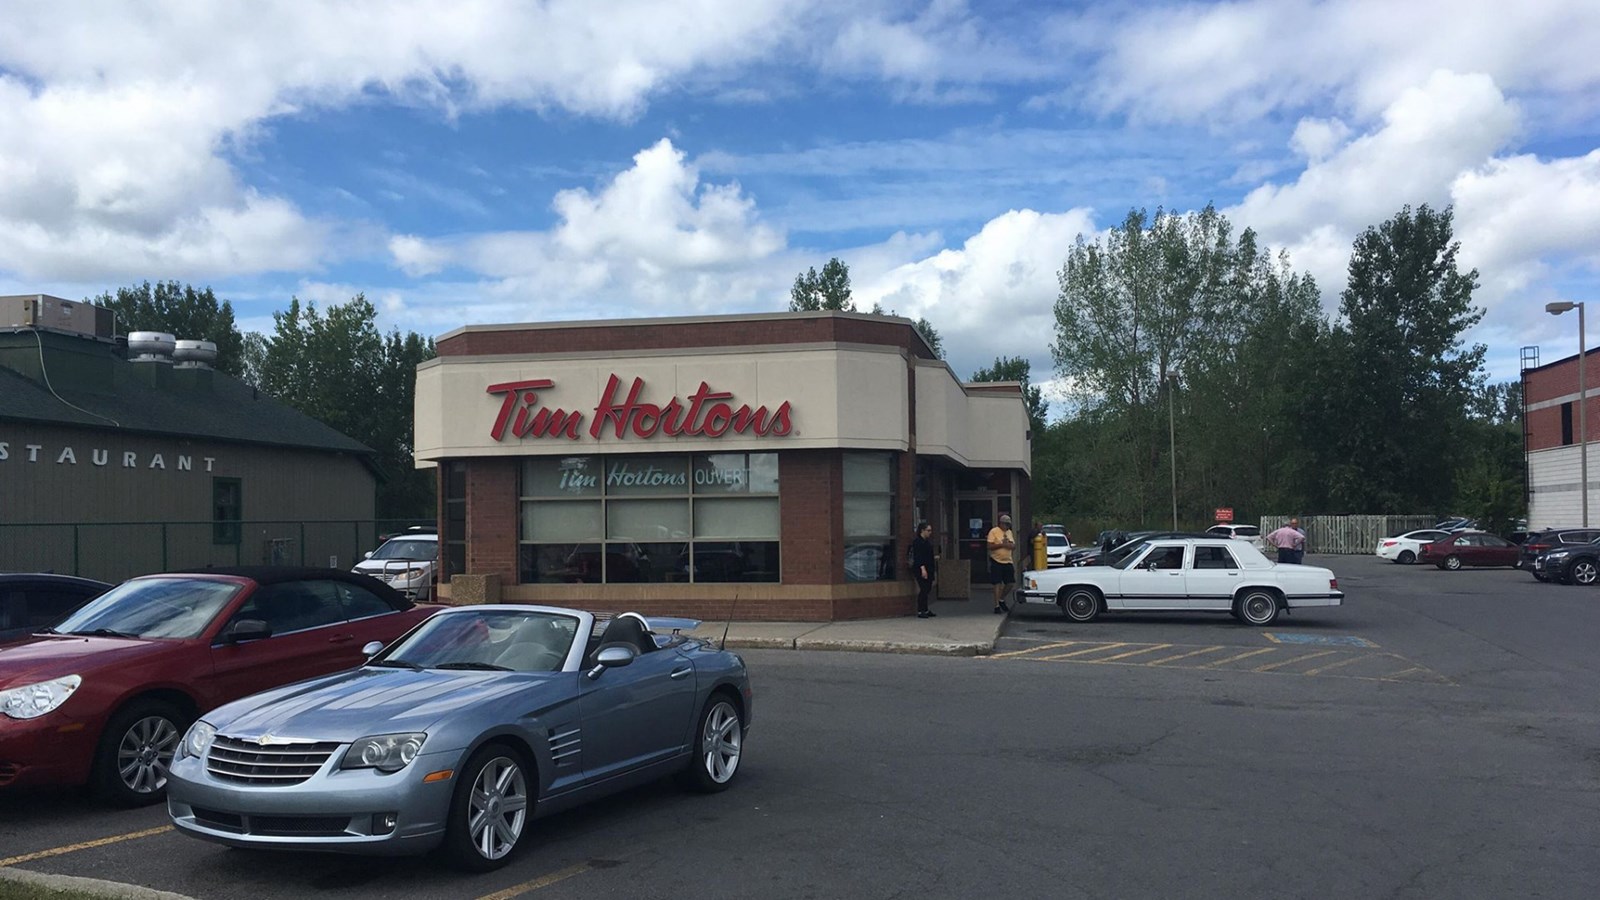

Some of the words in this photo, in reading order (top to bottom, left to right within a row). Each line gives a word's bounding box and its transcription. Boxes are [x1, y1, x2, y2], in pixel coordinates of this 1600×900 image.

[486, 379, 584, 442] Tim
[589, 373, 794, 440] Hortons
[0, 442, 216, 472] STAURANT
[559, 466, 596, 489] Tim
[606, 463, 687, 487] Hortons
[695, 468, 750, 485] OUVERT
